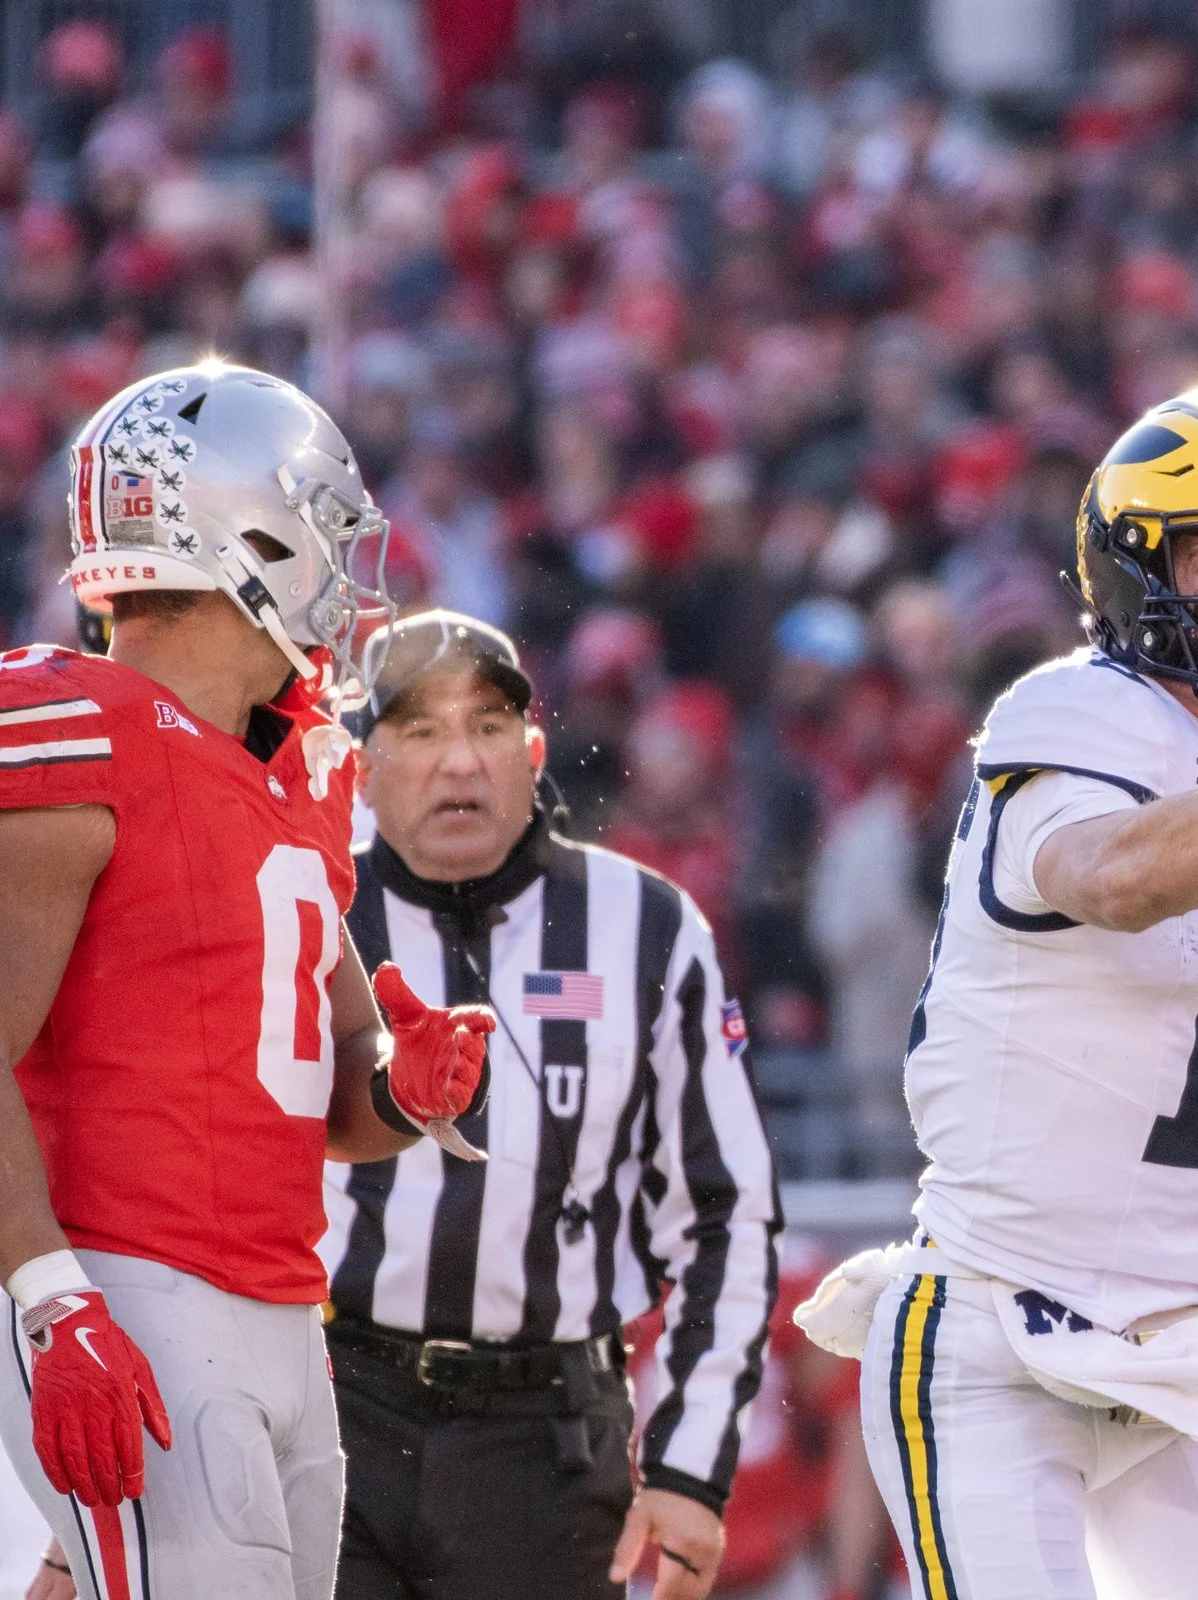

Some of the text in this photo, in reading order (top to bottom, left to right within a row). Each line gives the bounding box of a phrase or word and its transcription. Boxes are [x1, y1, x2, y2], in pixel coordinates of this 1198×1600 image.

[256, 844, 340, 1119] 0
[543, 1064, 584, 1118] U
[1013, 1288, 1094, 1336] M
